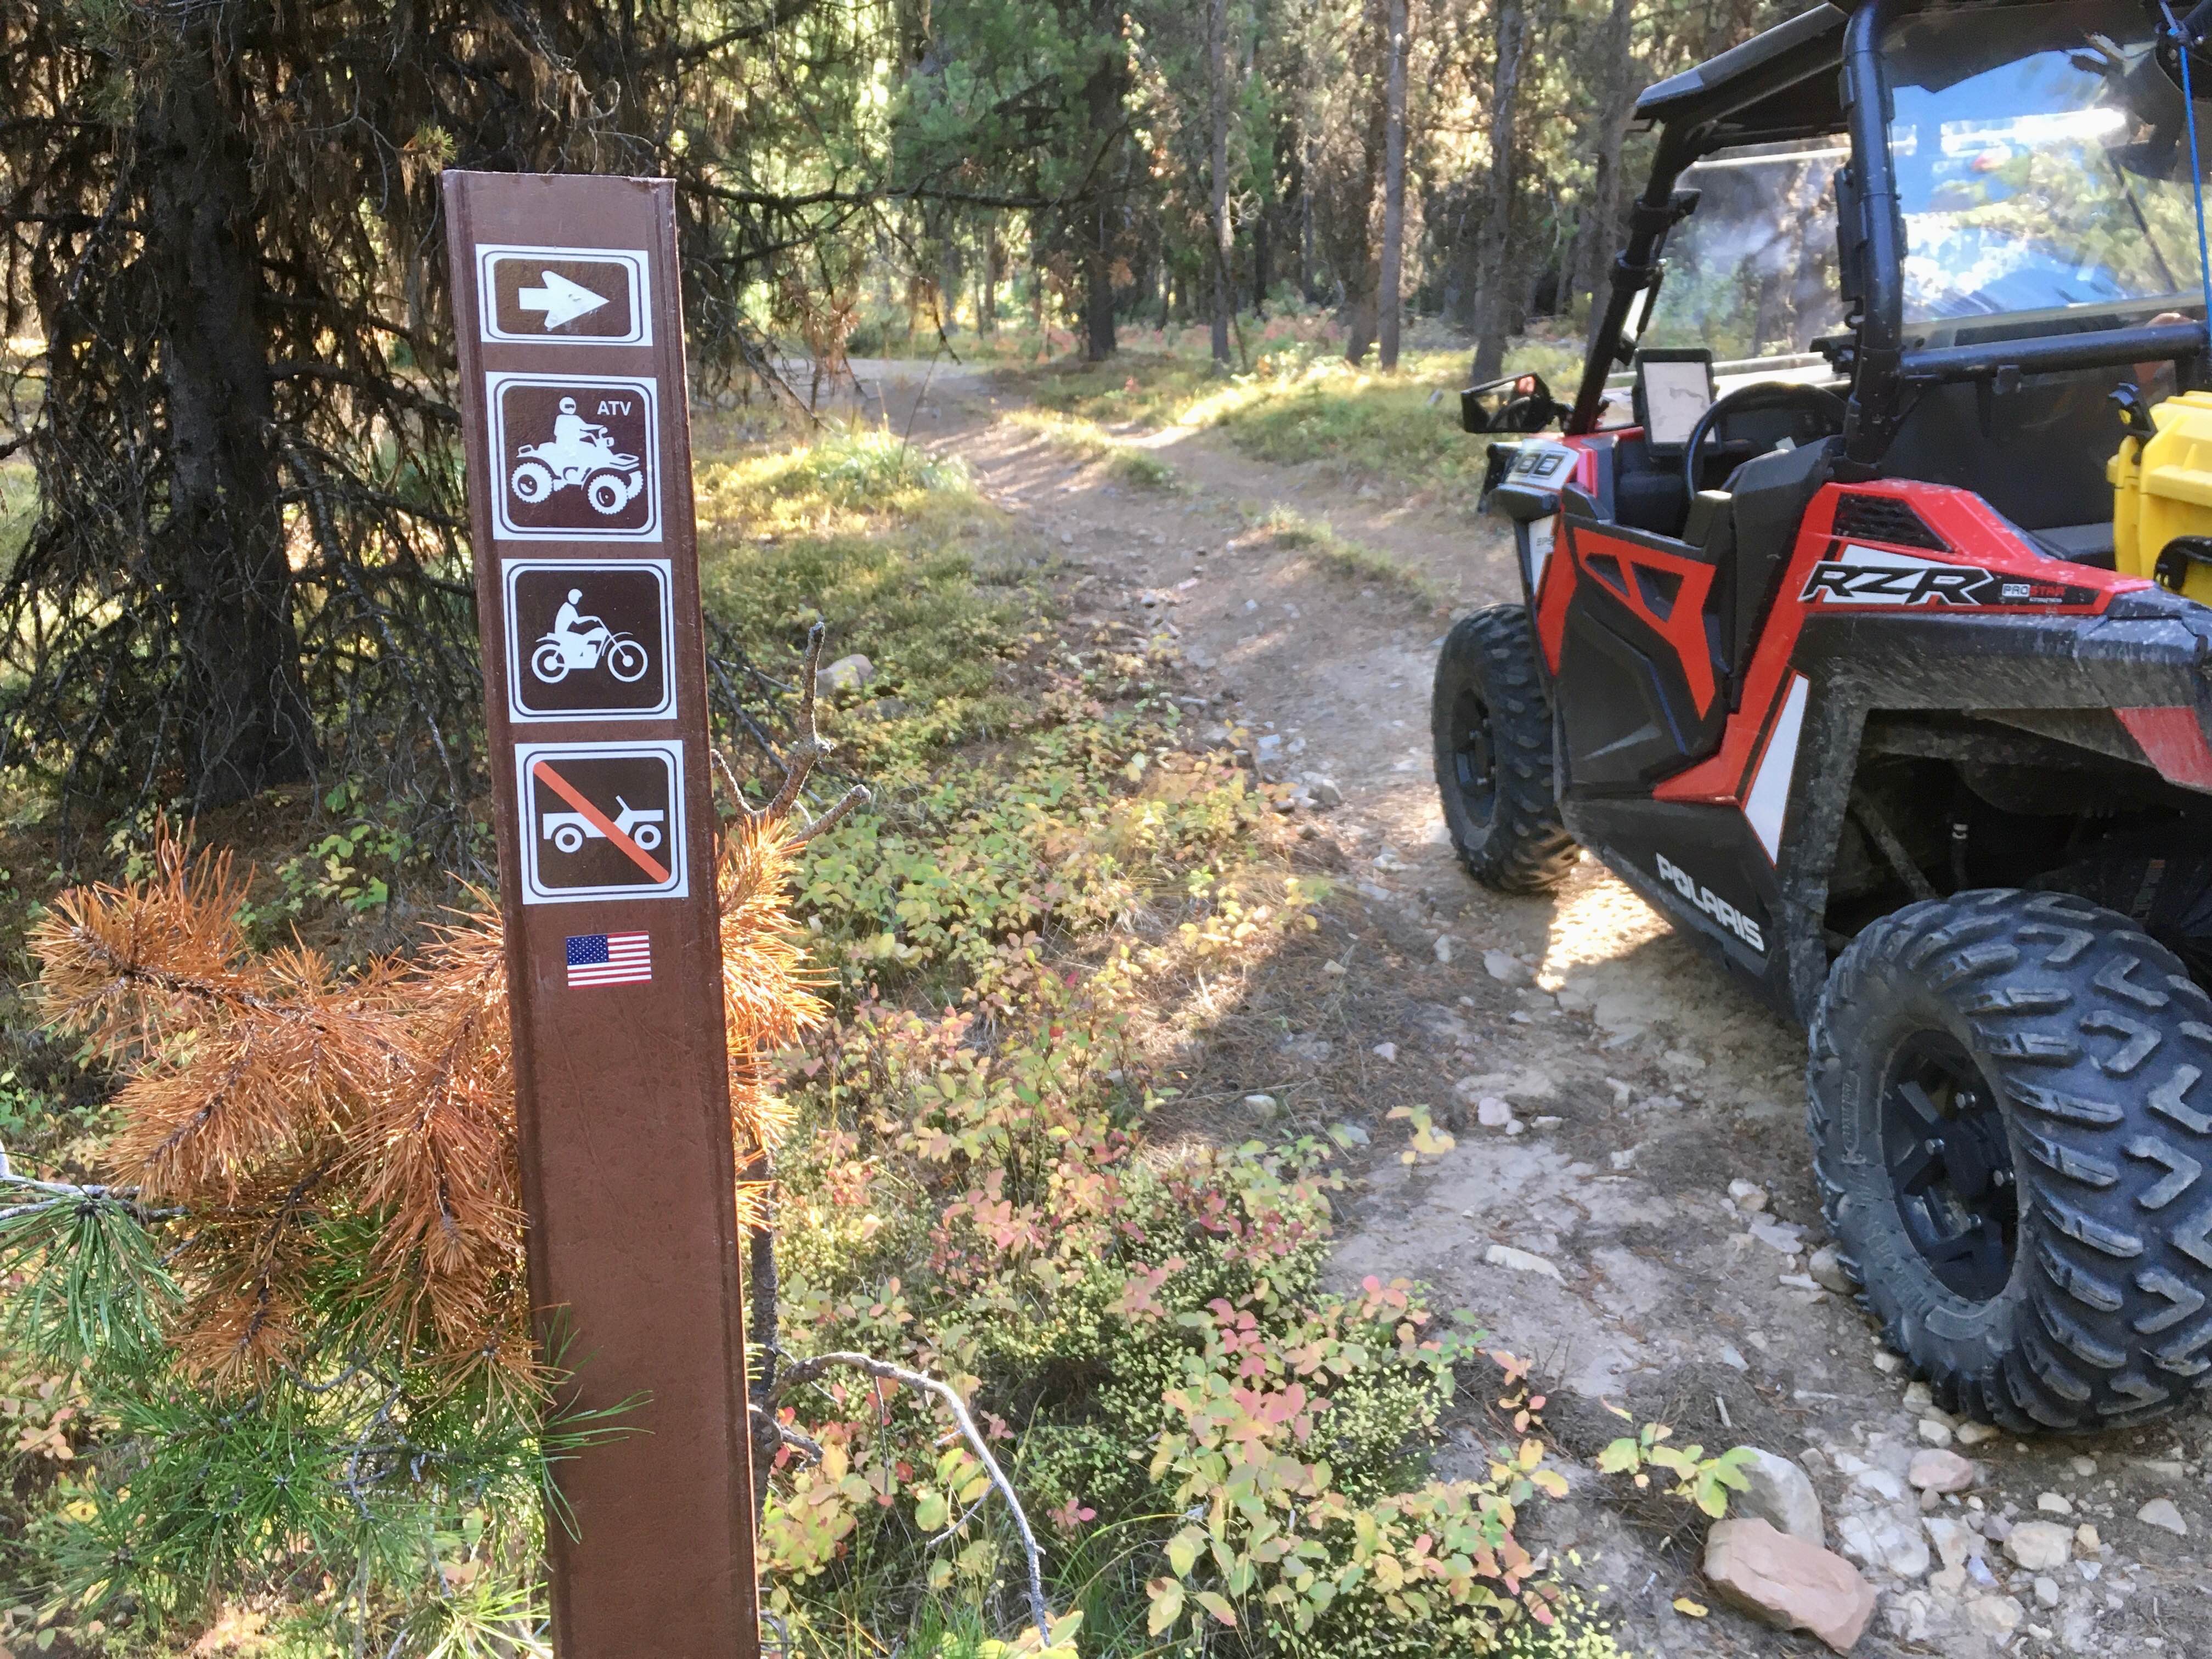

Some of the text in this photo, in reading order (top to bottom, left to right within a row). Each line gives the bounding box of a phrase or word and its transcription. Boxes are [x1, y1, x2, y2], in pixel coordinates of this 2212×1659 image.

[597, 400, 631, 416] ATV
[1797, 561, 1994, 605] RZR
[1656, 851, 1764, 951] POLARIS
